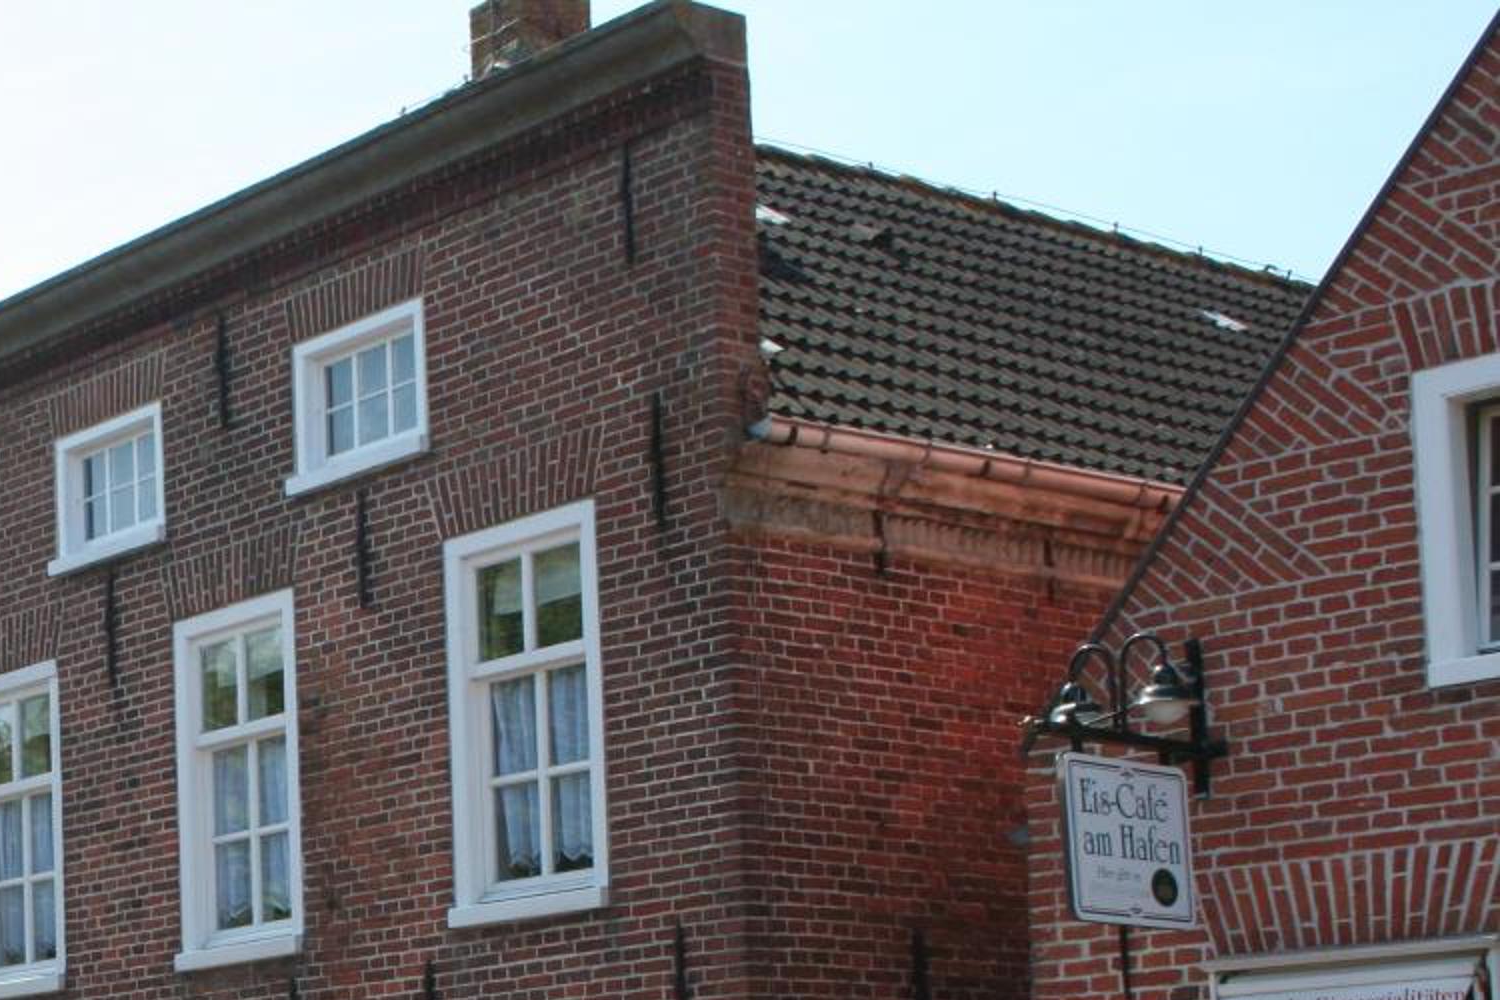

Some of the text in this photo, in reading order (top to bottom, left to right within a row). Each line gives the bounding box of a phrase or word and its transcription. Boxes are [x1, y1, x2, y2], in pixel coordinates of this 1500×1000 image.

[1079, 777, 1169, 823] Eis-Café
[1083, 823, 1181, 865] am Hafen
